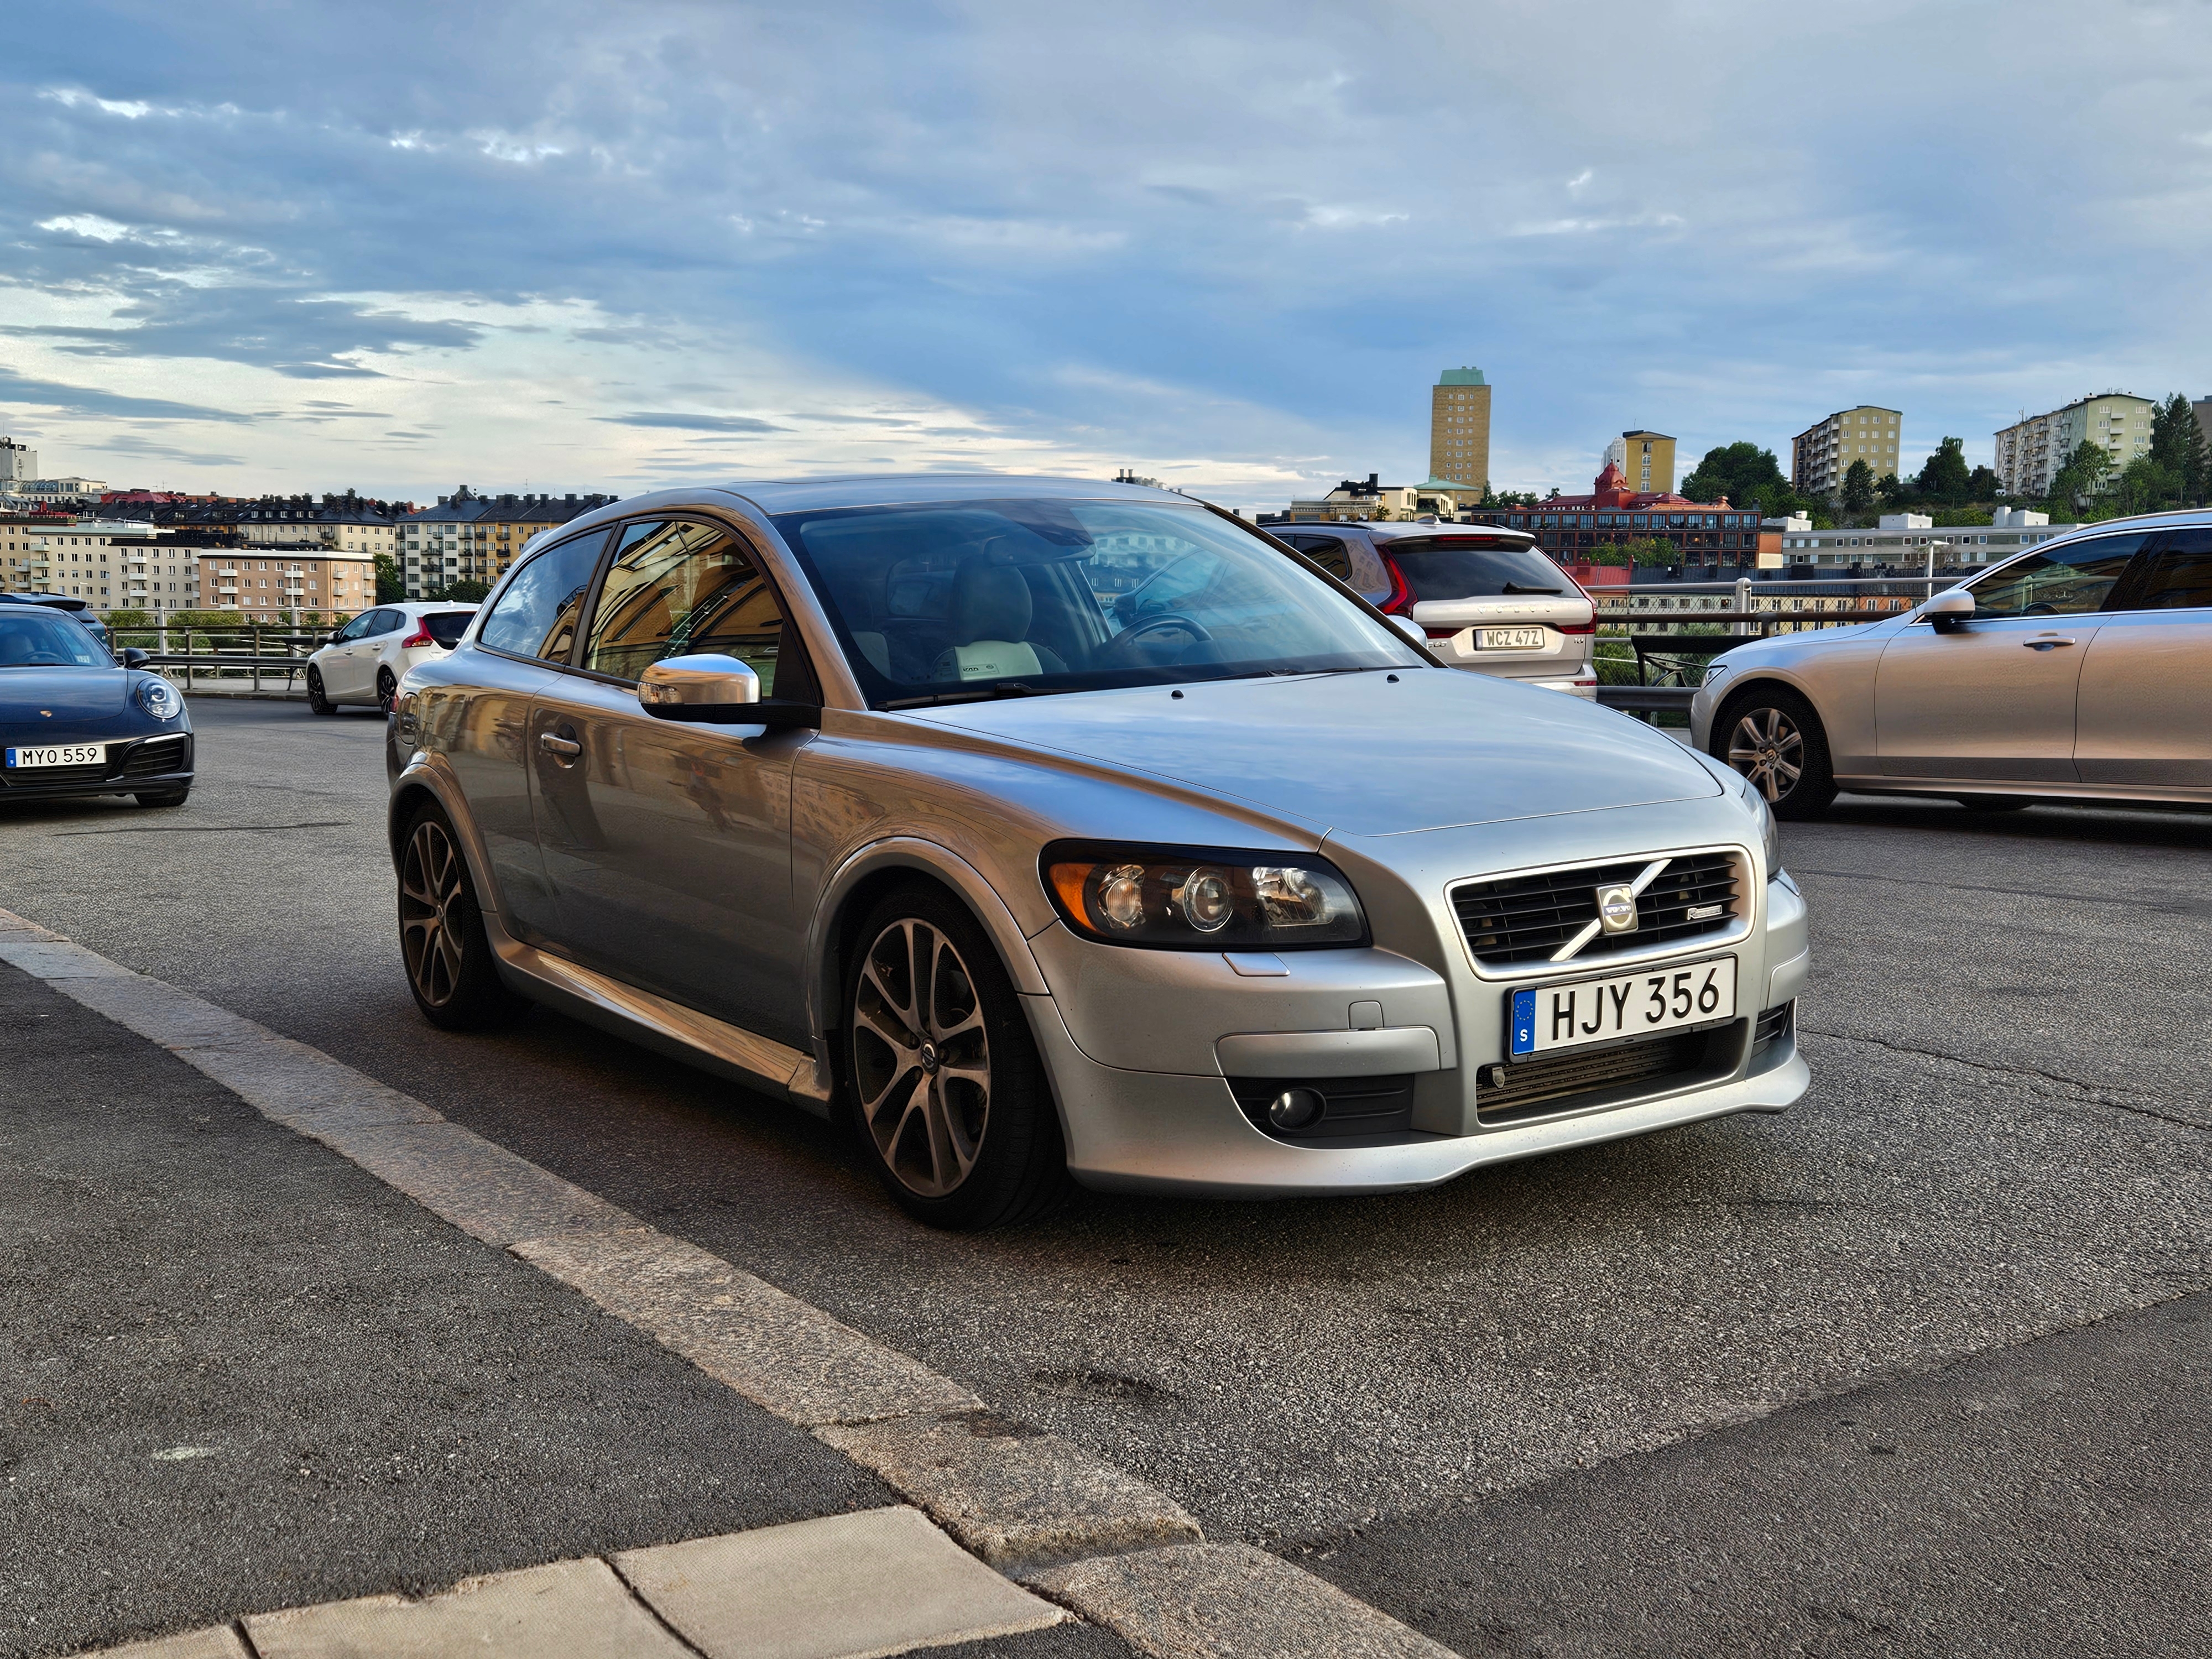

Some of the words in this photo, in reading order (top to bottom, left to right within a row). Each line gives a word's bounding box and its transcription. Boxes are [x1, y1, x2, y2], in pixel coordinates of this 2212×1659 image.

[1486, 631, 1511, 646] WCZ
[1515, 630, 1539, 645] 47Z
[22, 749, 58, 765] MYO
[63, 748, 97, 763] 559
[1552, 980, 1632, 1041] HJY
[1645, 967, 1720, 1024] 356
[1519, 1029, 1528, 1042] S
